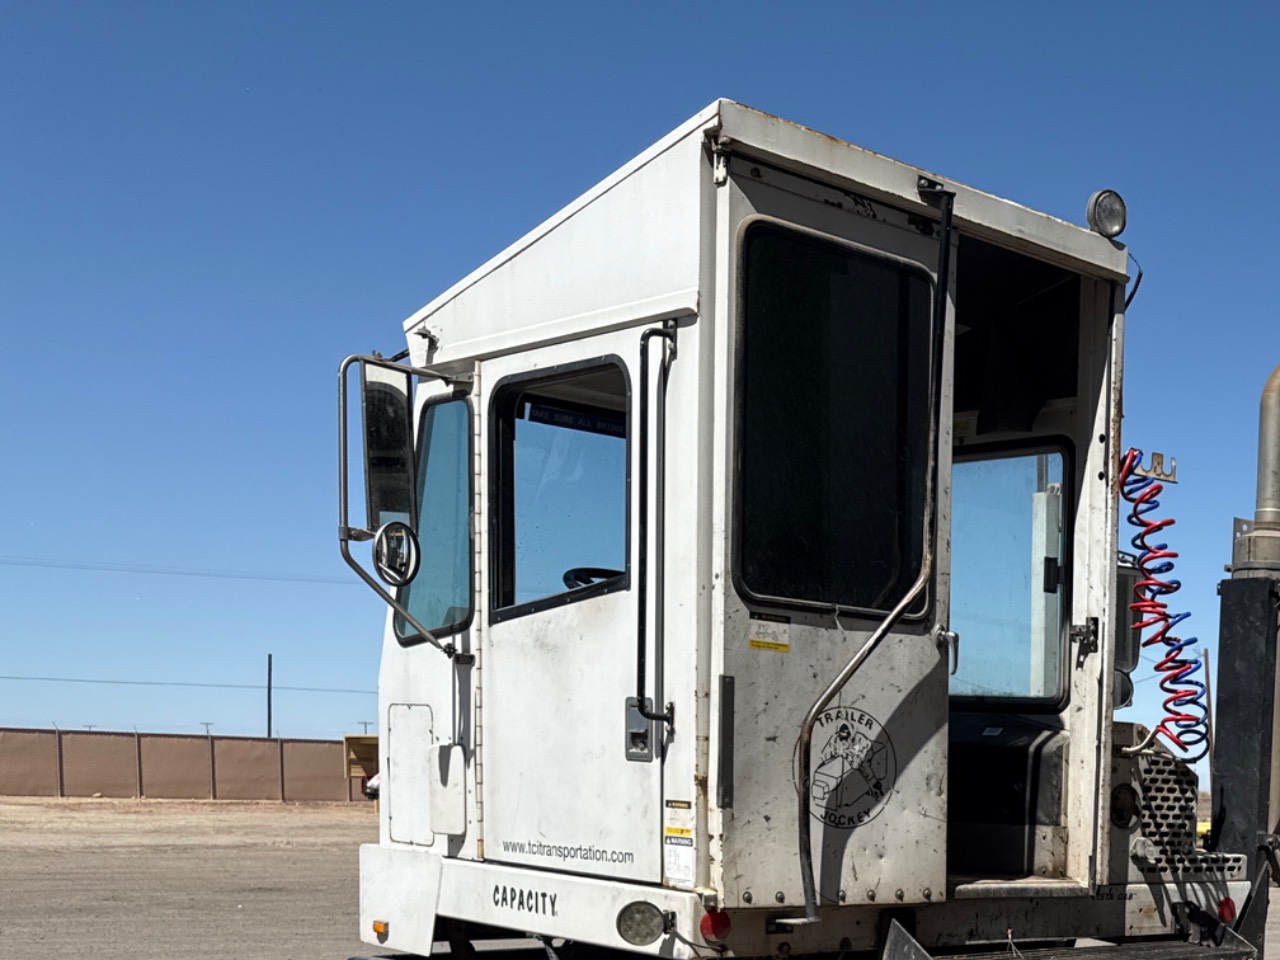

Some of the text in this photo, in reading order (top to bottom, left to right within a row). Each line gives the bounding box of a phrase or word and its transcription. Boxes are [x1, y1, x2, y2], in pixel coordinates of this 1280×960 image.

[577, 417, 593, 428] ALL
[815, 709, 874, 731] TRAILER
[820, 808, 871, 825] JOCKEY
[503, 840, 634, 863] www.tcitransportation.com
[493, 884, 558, 916] CAPACITY
